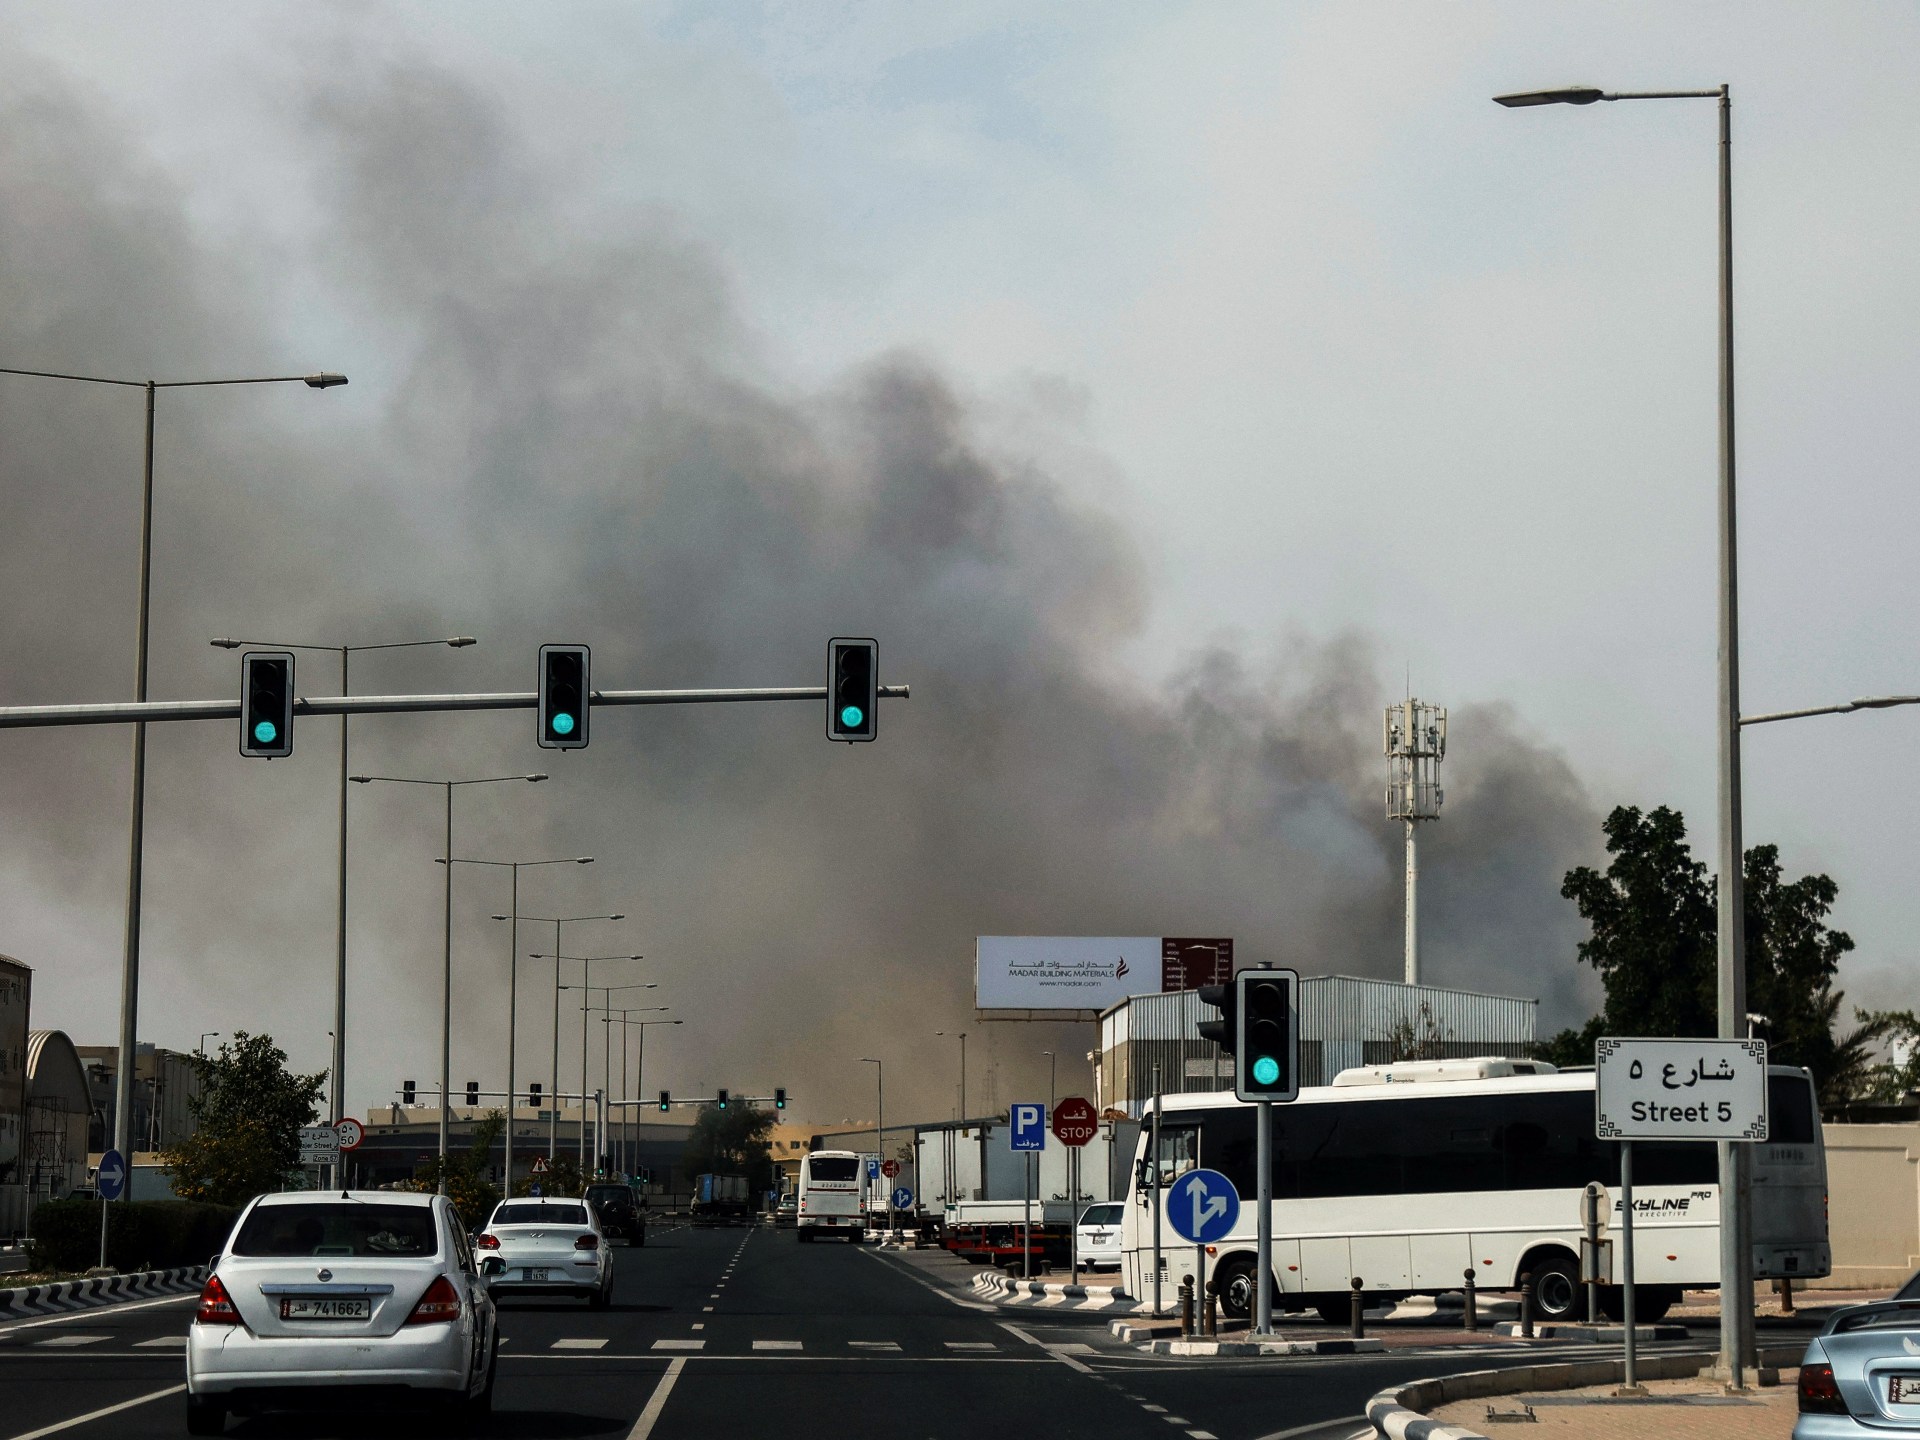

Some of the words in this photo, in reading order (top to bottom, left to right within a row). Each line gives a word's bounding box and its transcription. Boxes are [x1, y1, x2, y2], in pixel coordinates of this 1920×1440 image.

[1008, 969, 1039, 977] MADAR
[1073, 970, 1115, 978] MATERIALS
[1629, 1059, 1643, 1080] ٥
[1662, 1056, 1735, 1090] شارع
[1062, 1106, 1087, 1120] قف
[1631, 1101, 1709, 1122] Street
[1717, 1101, 1732, 1122] 5
[1017, 1106, 1039, 1135] P
[341, 1136, 354, 1144] 50
[1060, 1127, 1093, 1139] STOP
[1016, 1139, 1040, 1149] موقف
[1691, 1191, 1712, 1201] PRO
[313, 1302, 362, 1316] 741662
